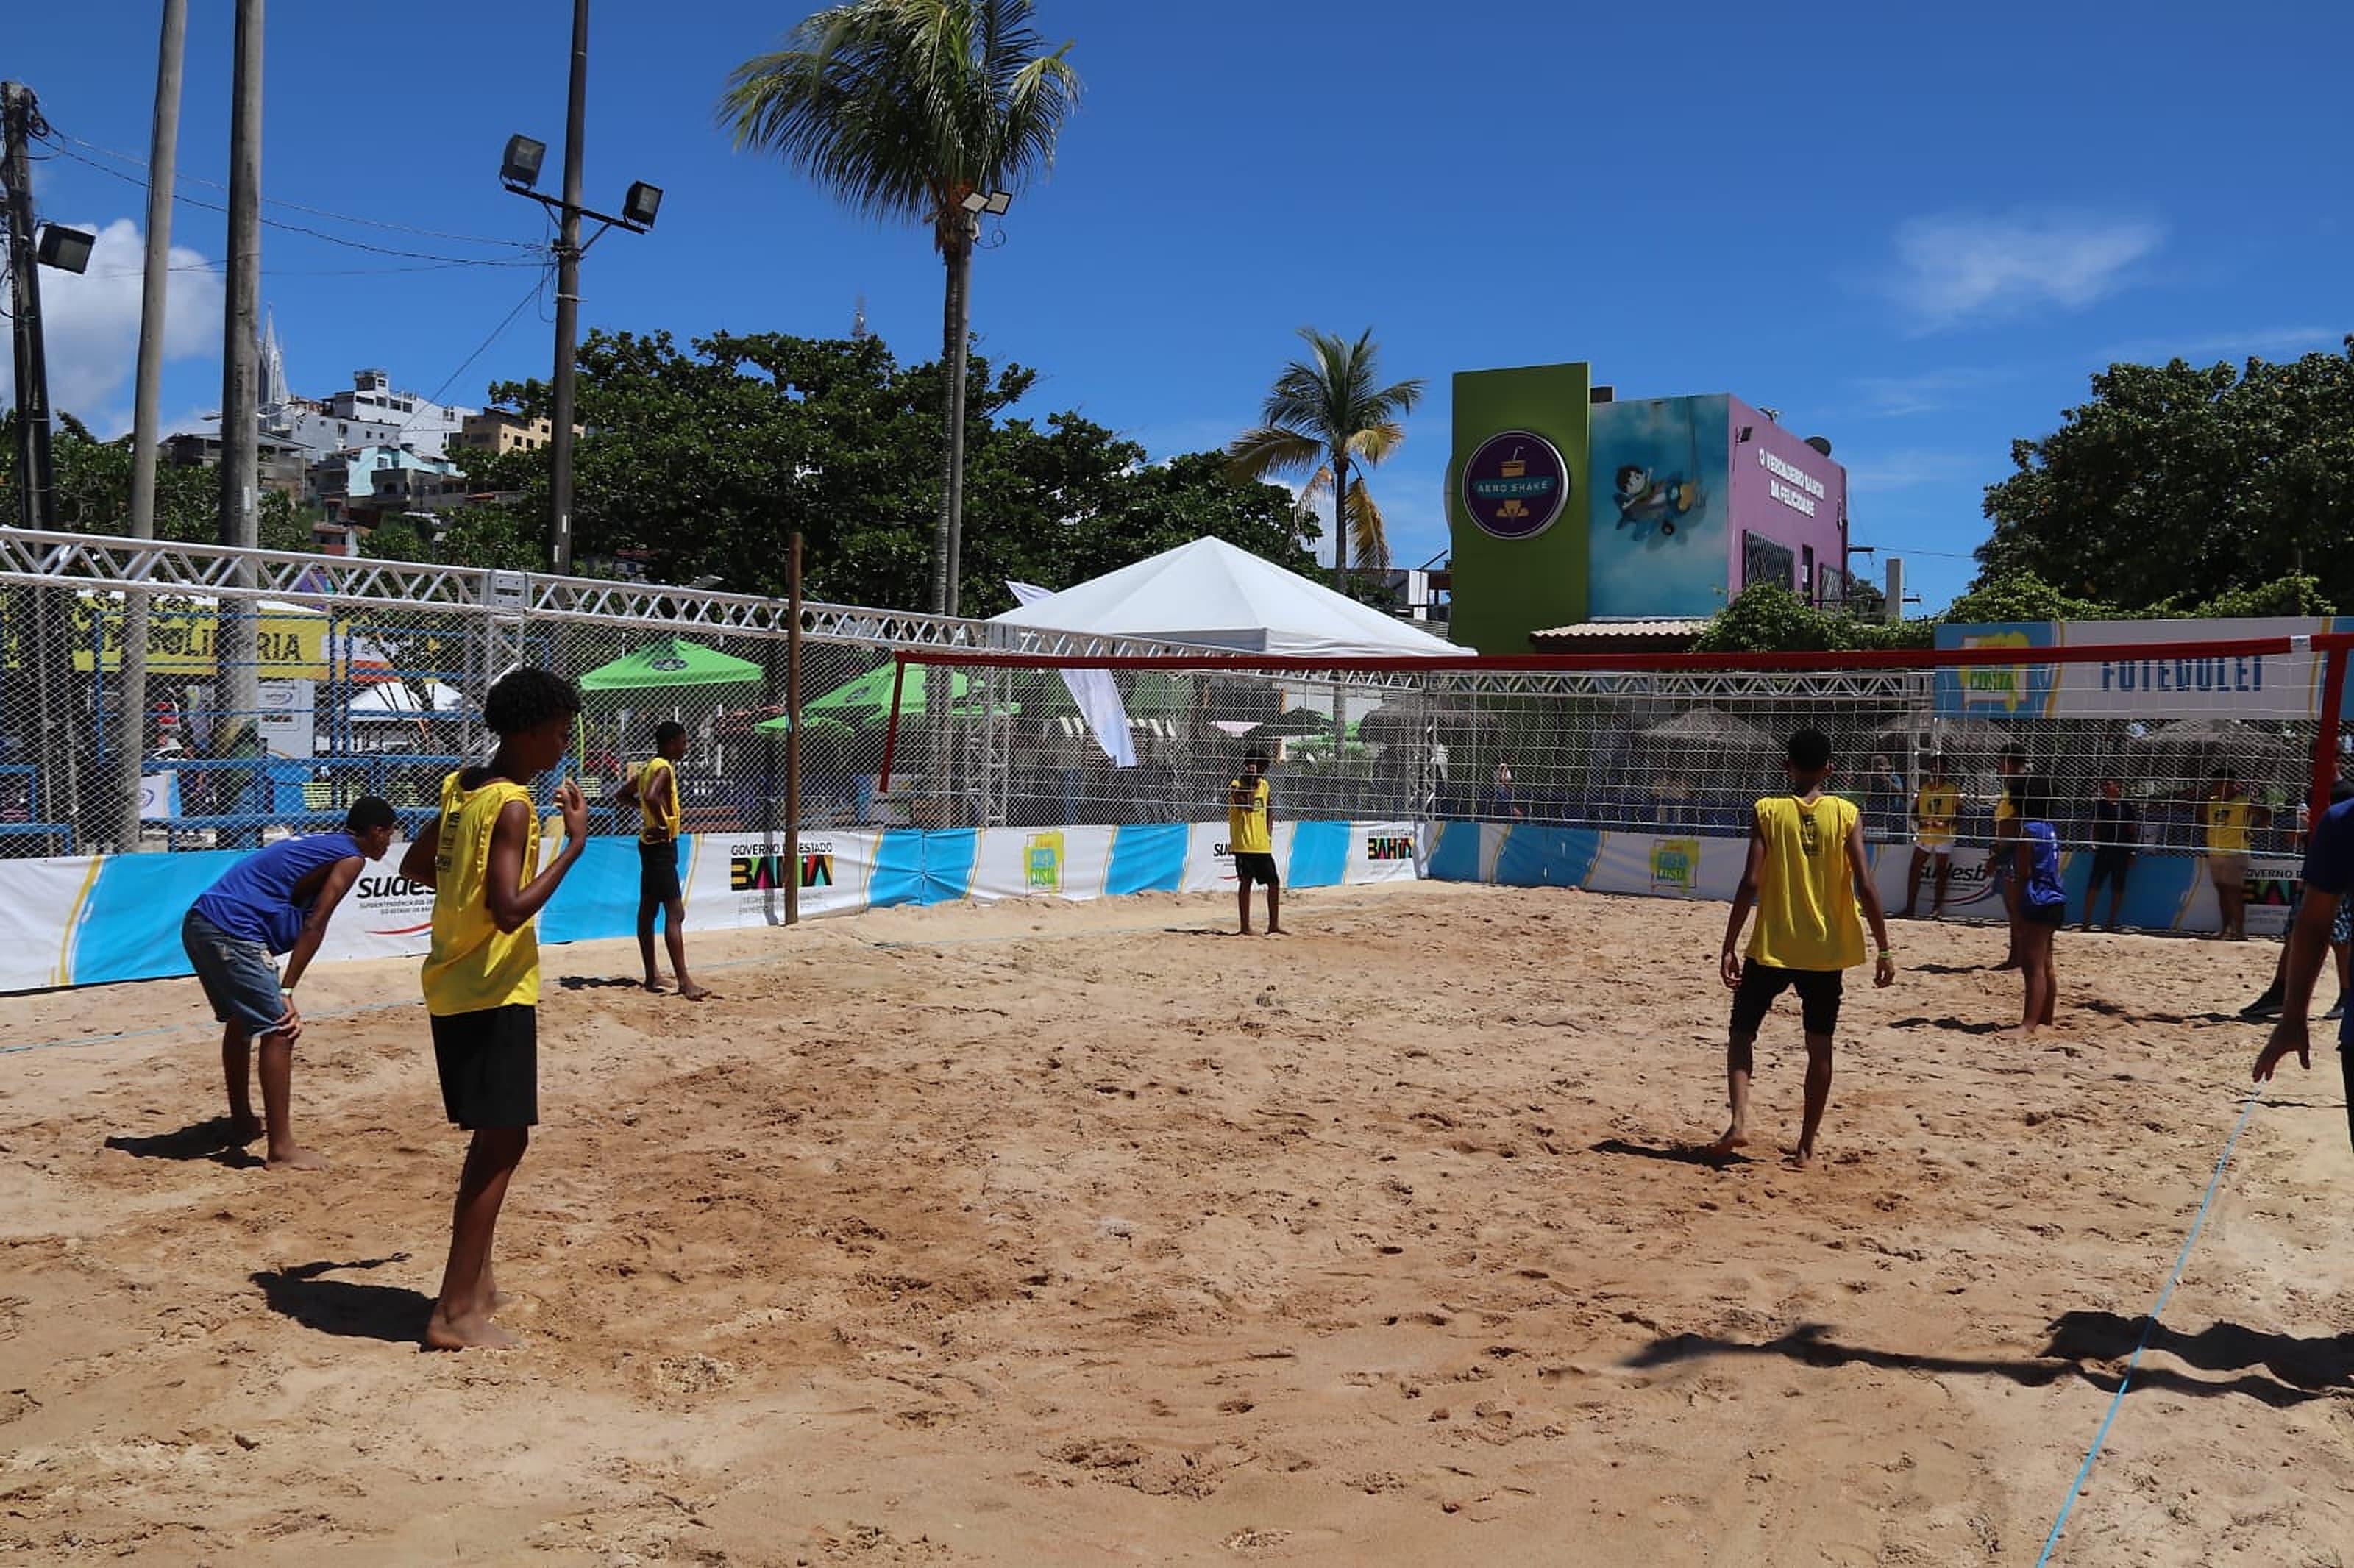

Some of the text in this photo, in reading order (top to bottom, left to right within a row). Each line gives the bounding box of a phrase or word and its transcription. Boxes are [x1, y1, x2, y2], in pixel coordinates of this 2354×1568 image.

[1478, 480, 1549, 493] AERO SHAKE
[730, 842, 833, 856] GOVERNO ESTADO
[1368, 838, 1413, 859] BAHIA
